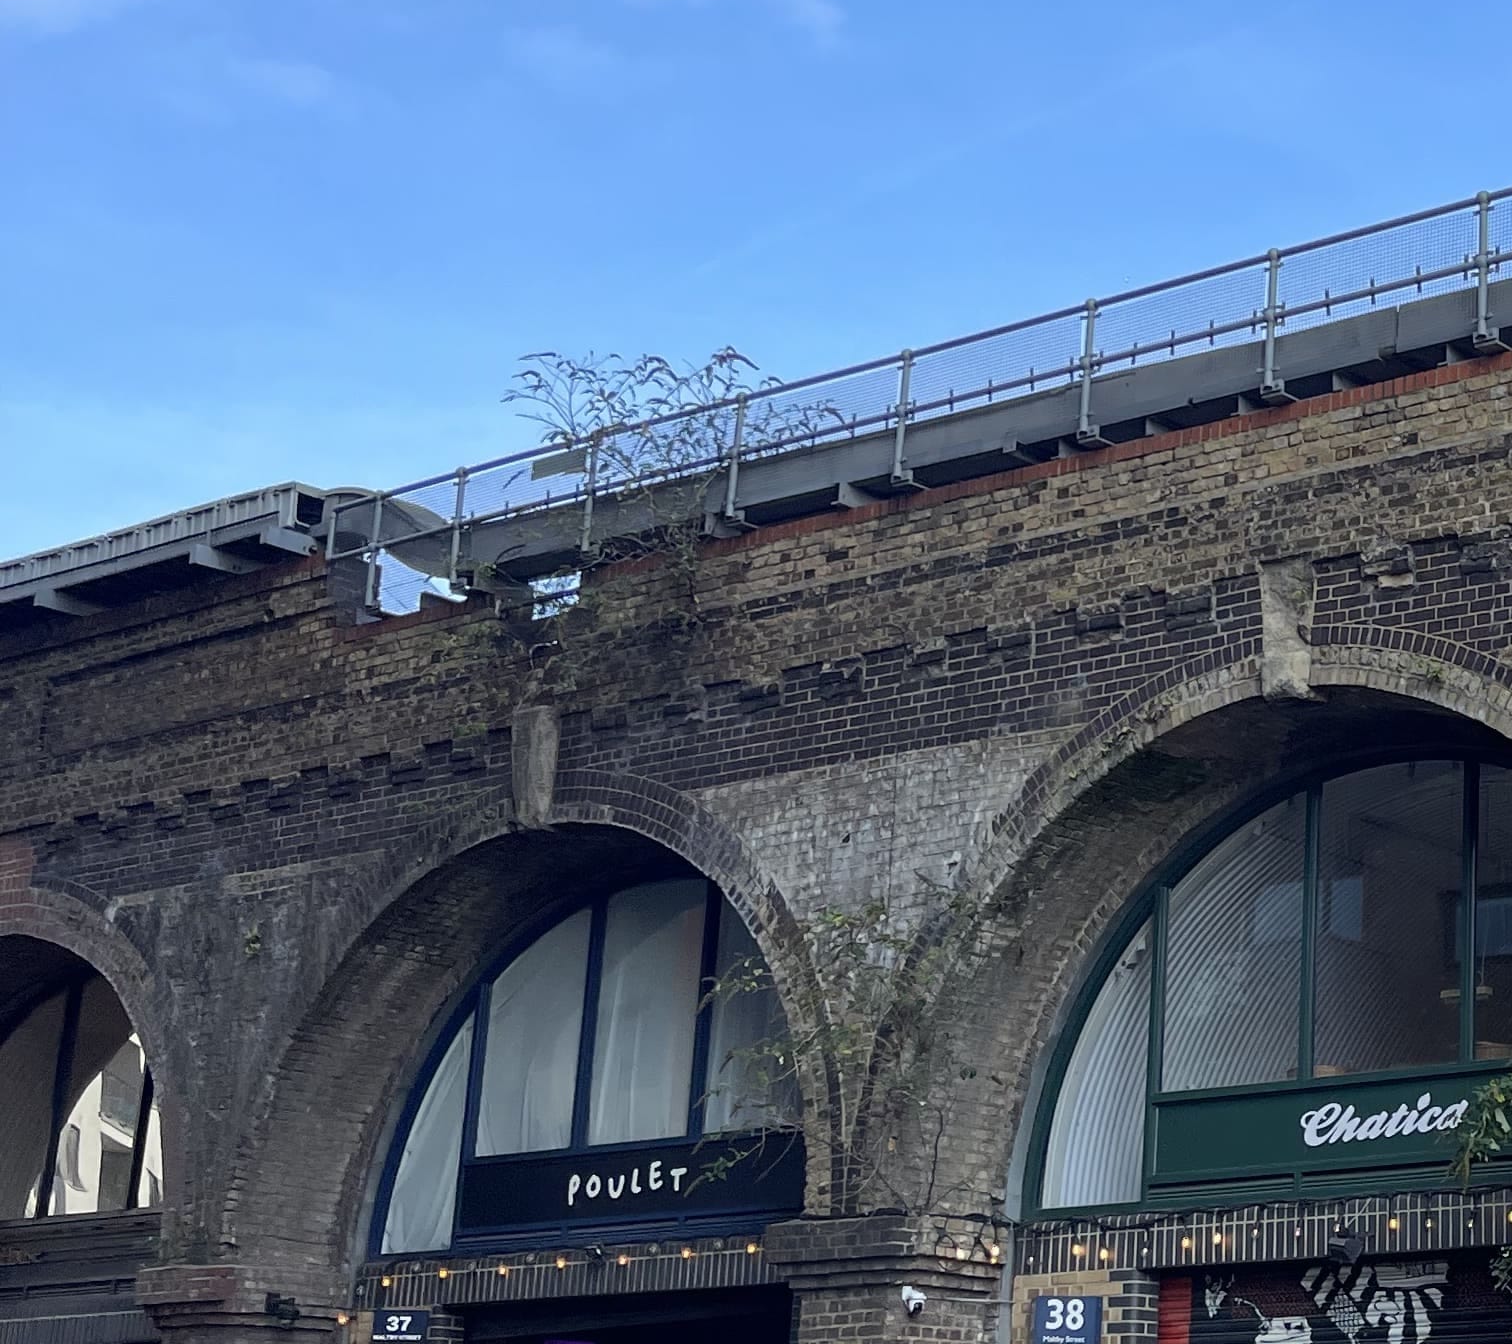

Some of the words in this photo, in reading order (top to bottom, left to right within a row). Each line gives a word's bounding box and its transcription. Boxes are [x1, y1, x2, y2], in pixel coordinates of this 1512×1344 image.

[1300, 1092, 1469, 1147] Chatica
[567, 1160, 688, 1206] POULET
[385, 1315, 412, 1332] 37
[1045, 1298, 1085, 1331] 38
